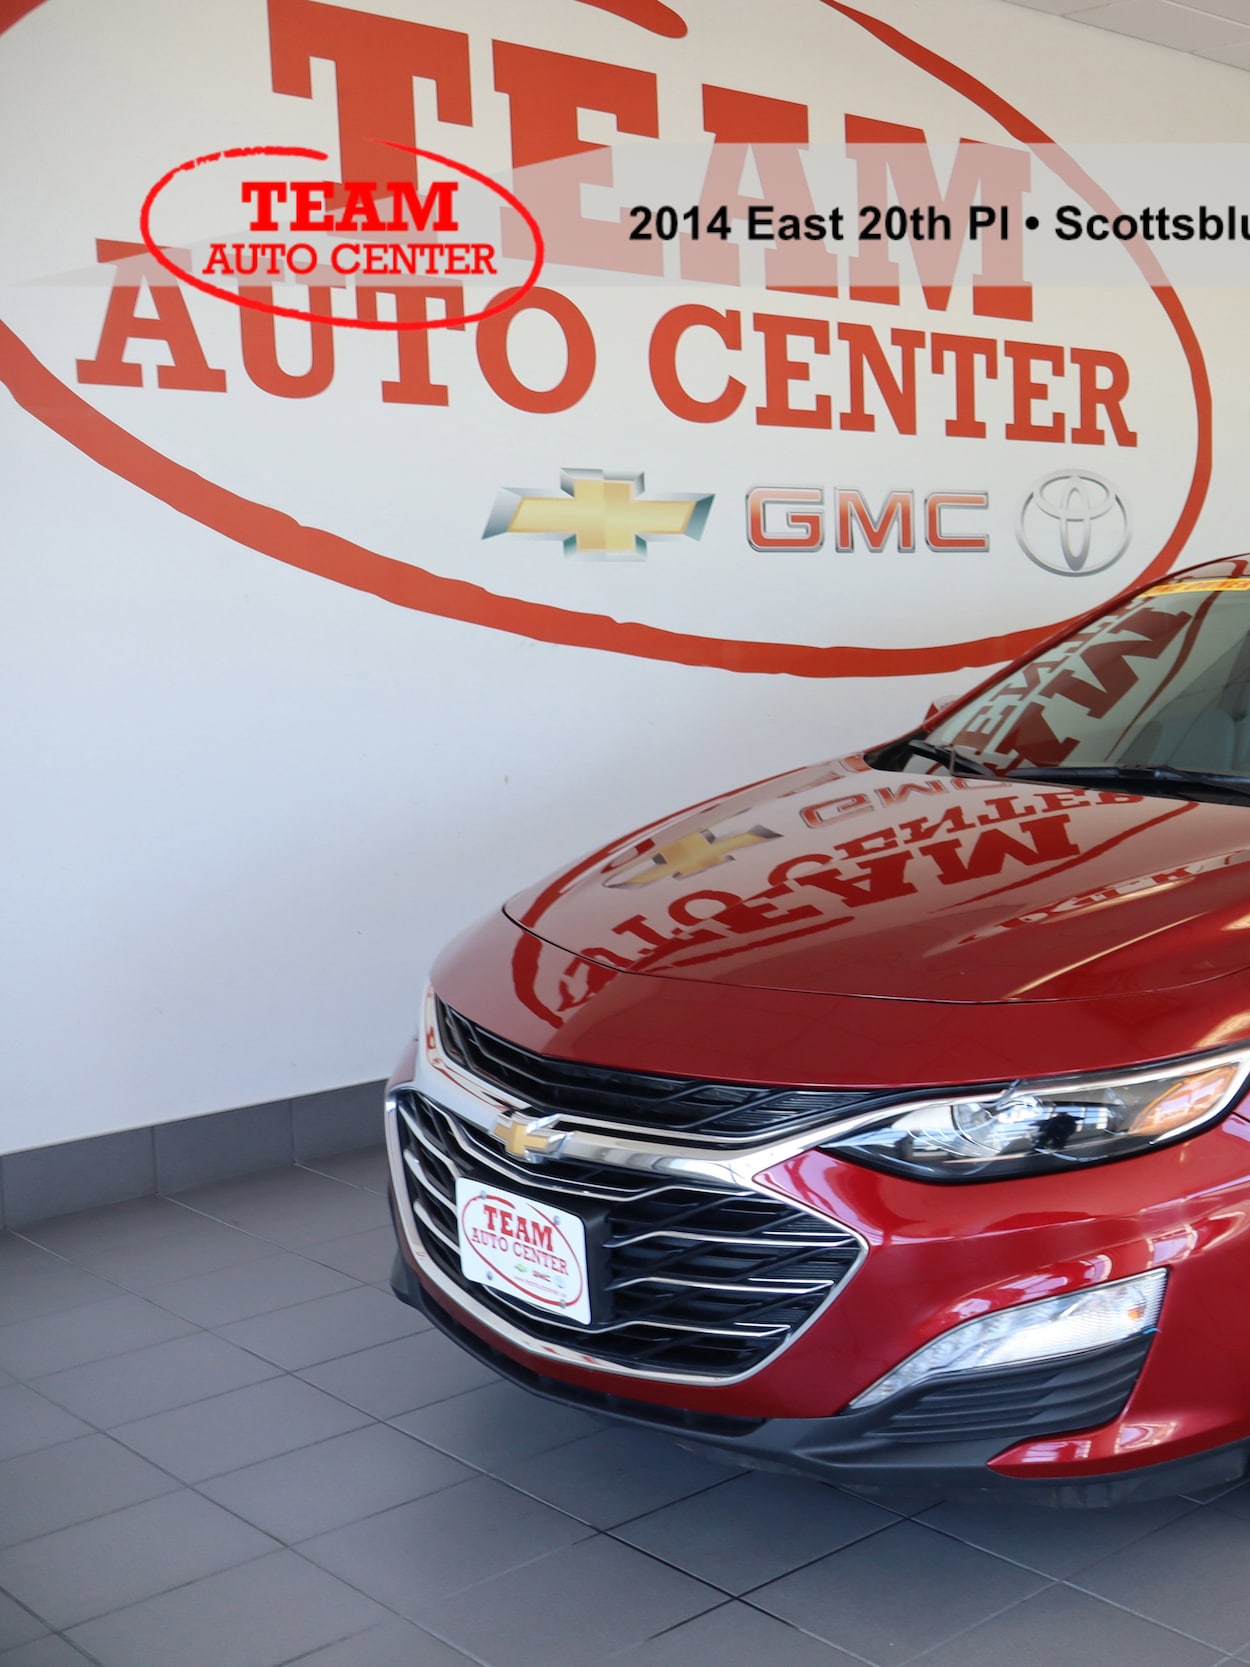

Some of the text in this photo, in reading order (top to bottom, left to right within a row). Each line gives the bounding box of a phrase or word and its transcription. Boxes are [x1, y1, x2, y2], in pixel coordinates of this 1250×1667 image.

[267, 0, 1033, 322] TEAM
[76, 238, 1138, 448] AUTO CENTER
[745, 484, 990, 555] GMC
[472, 1227, 569, 1276] AUTO CENTER
[483, 1204, 554, 1252] TEAM
